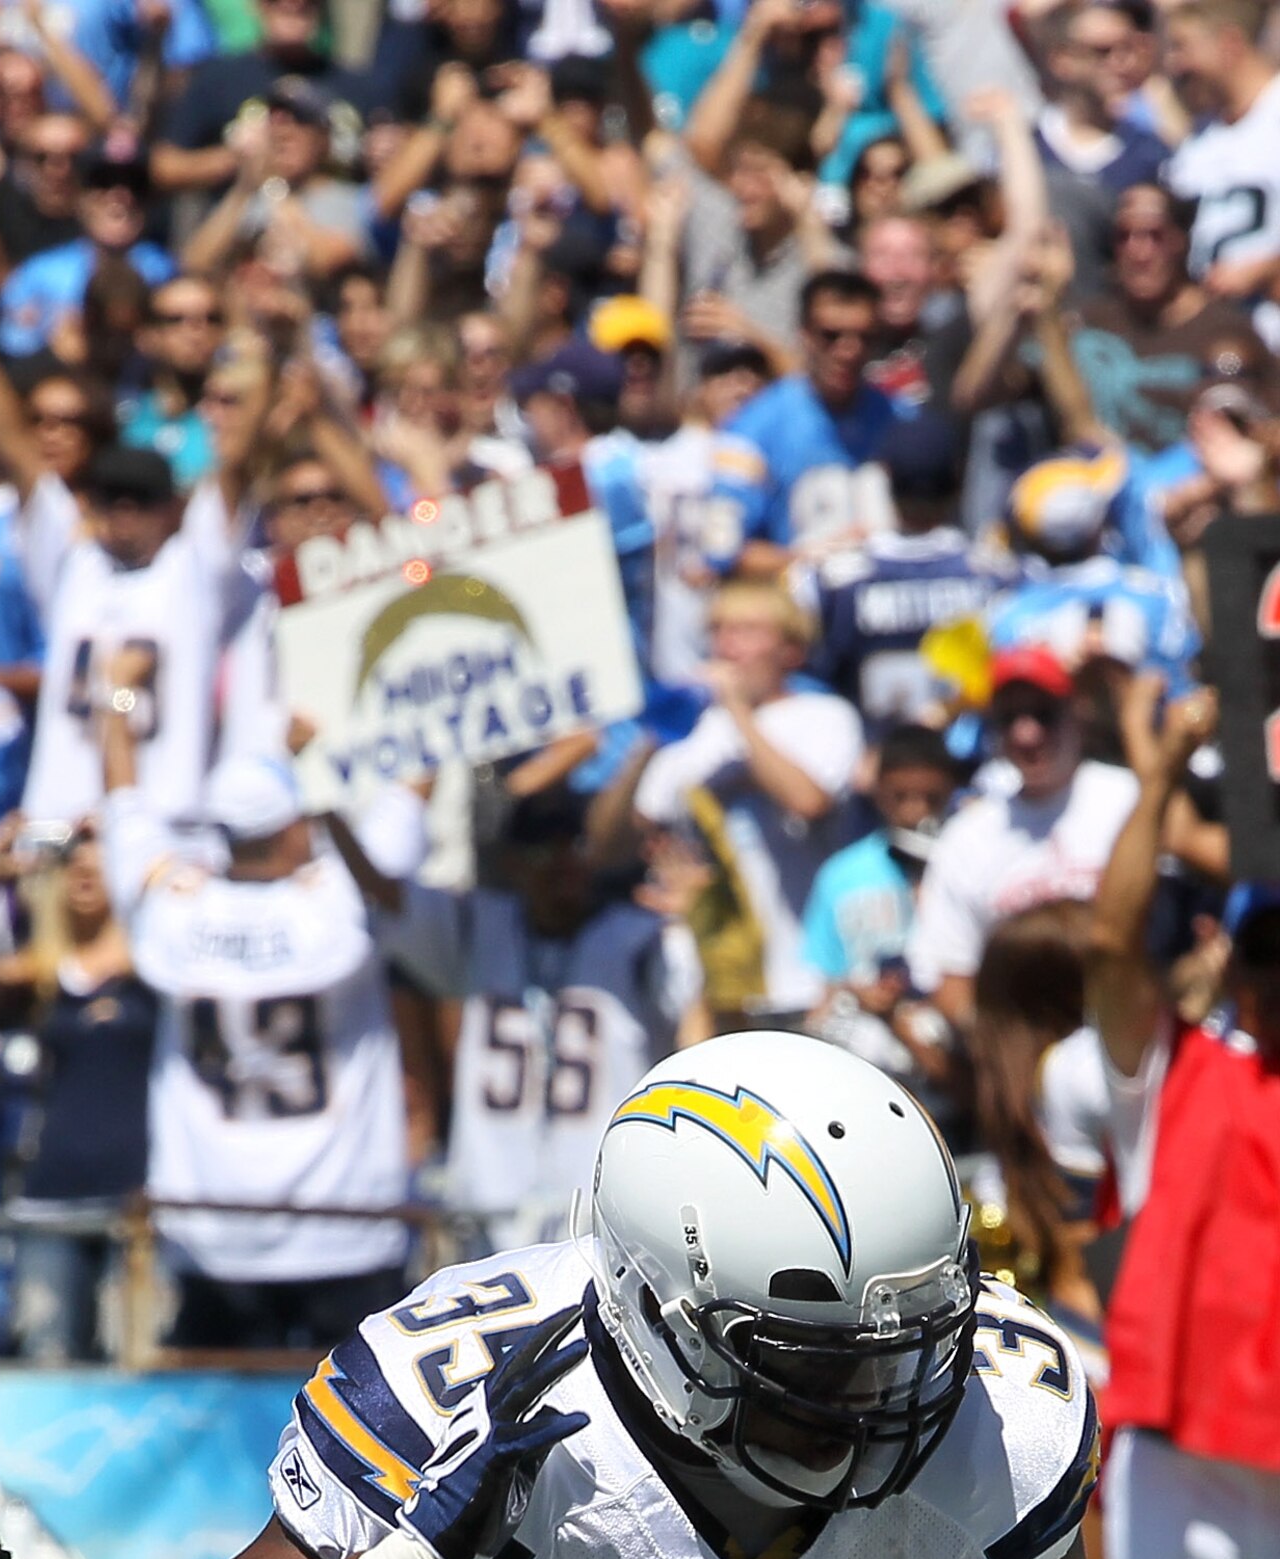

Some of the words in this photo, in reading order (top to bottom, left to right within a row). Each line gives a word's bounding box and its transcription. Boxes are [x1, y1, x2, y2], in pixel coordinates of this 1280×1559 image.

[297, 468, 560, 598] DANGER
[328, 672, 593, 785] VOLTAGE
[381, 643, 521, 712] HIGH
[184, 995, 328, 1125] 43
[484, 1000, 597, 1116] 56
[683, 1225, 699, 1245] 35
